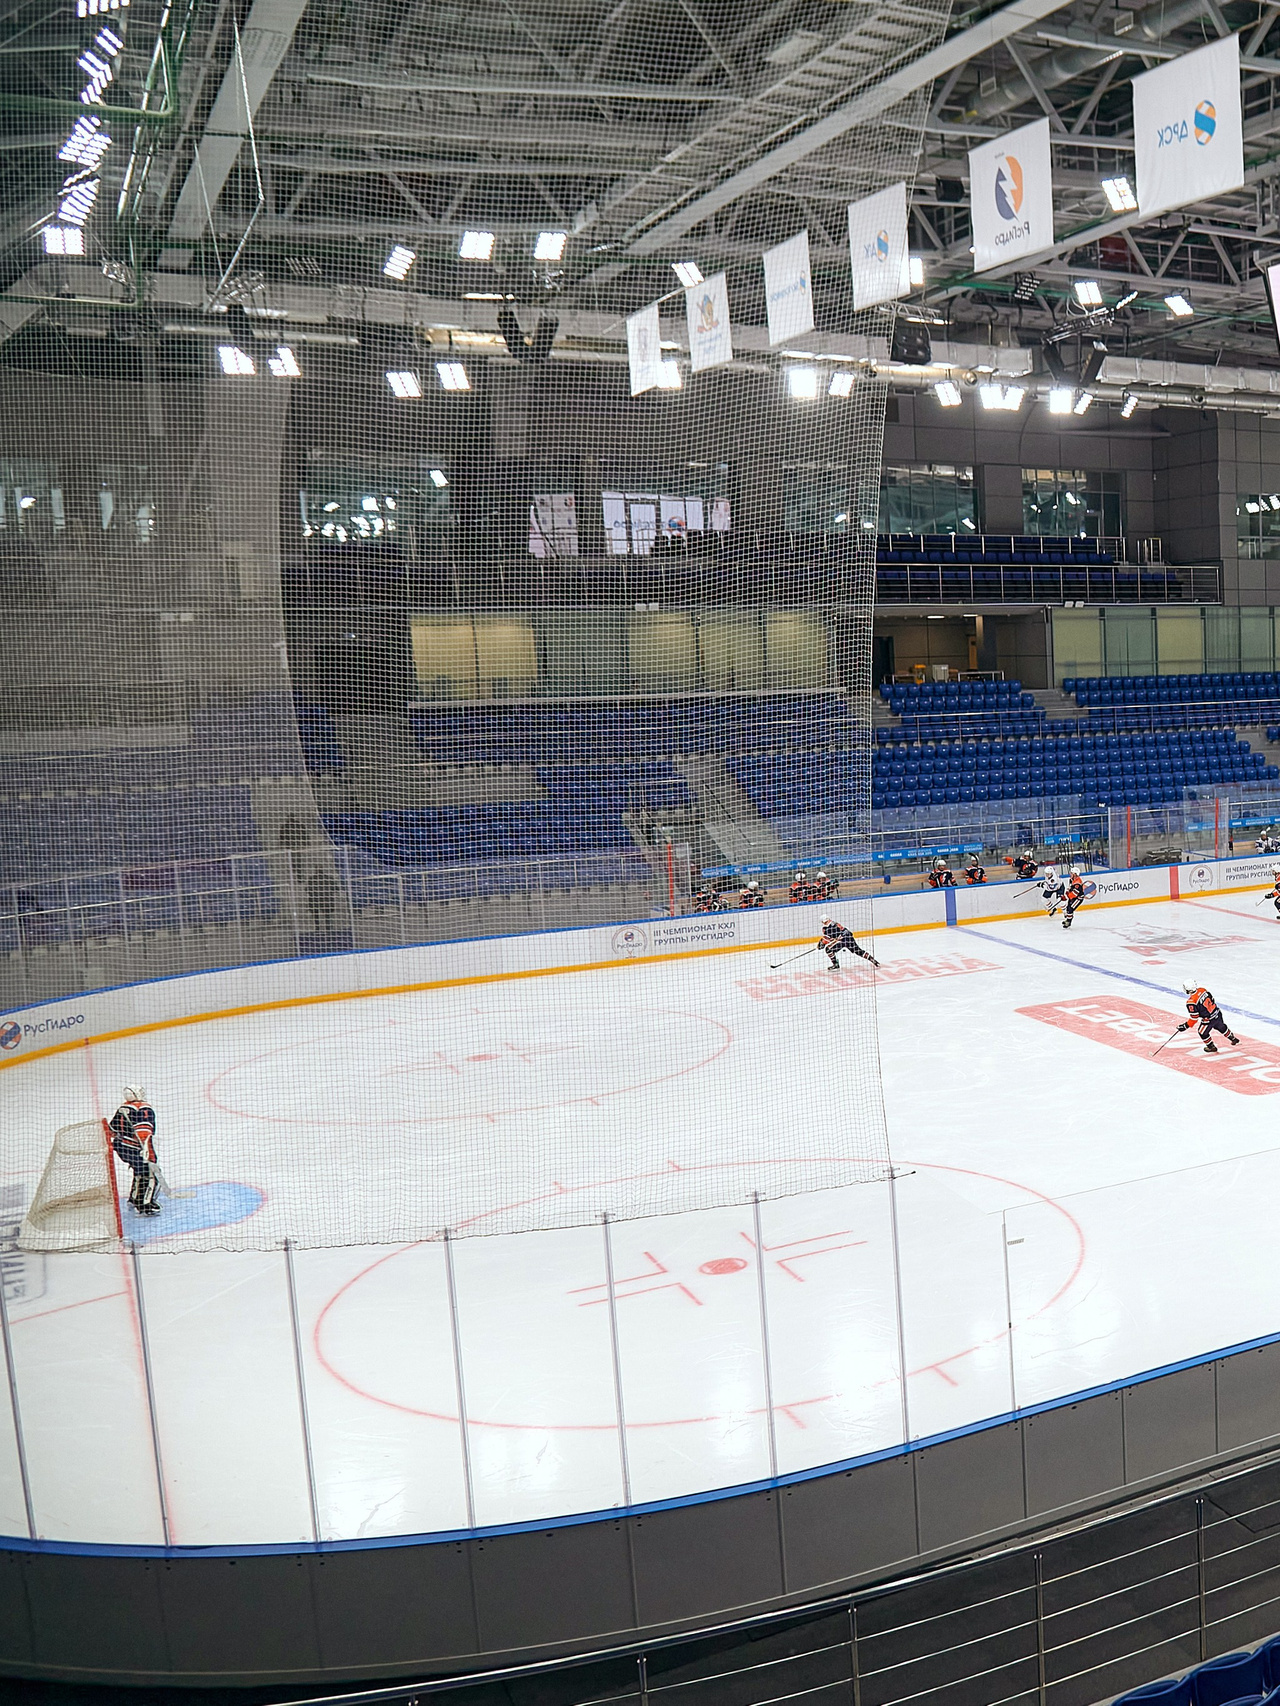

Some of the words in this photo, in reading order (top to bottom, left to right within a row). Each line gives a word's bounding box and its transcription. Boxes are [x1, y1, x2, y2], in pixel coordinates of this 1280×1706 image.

[1232, 864, 1268, 872] ЧЕМПИОНАТ
[1250, 871, 1273, 879] РУСГИД
[1098, 882, 1140, 894] РусГидро
[653, 929, 661, 937] III
[663, 923, 717, 936] ЧЕМПИОНАТ
[718, 921, 735, 930] КХЛ
[654, 936, 689, 946] ГРУППЫ
[690, 931, 735, 942] РУСГИДРО
[24, 1013, 84, 1036] РусГидро
